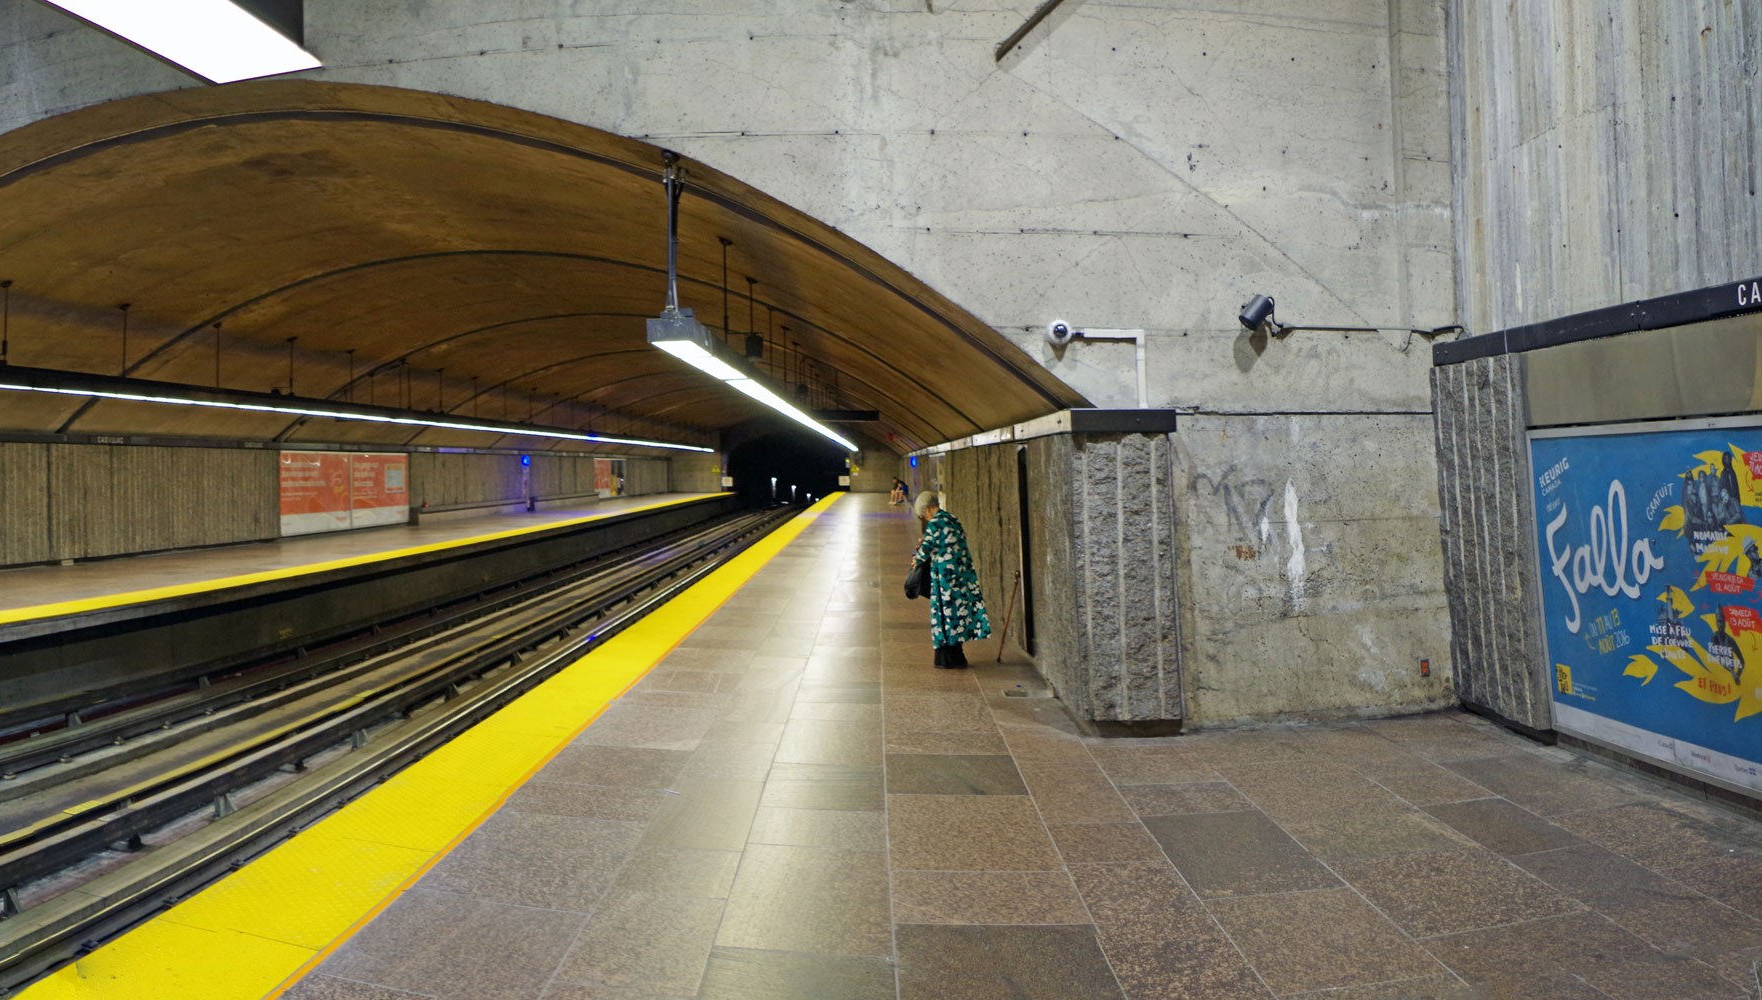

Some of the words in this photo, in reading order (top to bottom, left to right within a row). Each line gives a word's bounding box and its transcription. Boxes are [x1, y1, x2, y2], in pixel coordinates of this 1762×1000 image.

[1539, 456, 1570, 488] KEURIG
[1541, 478, 1562, 497] CANADA
[1545, 478, 1665, 634] Falla
[1676, 625, 1691, 636] FEU
[1651, 636, 1662, 646] DE
[1698, 677, 1707, 689] ET
